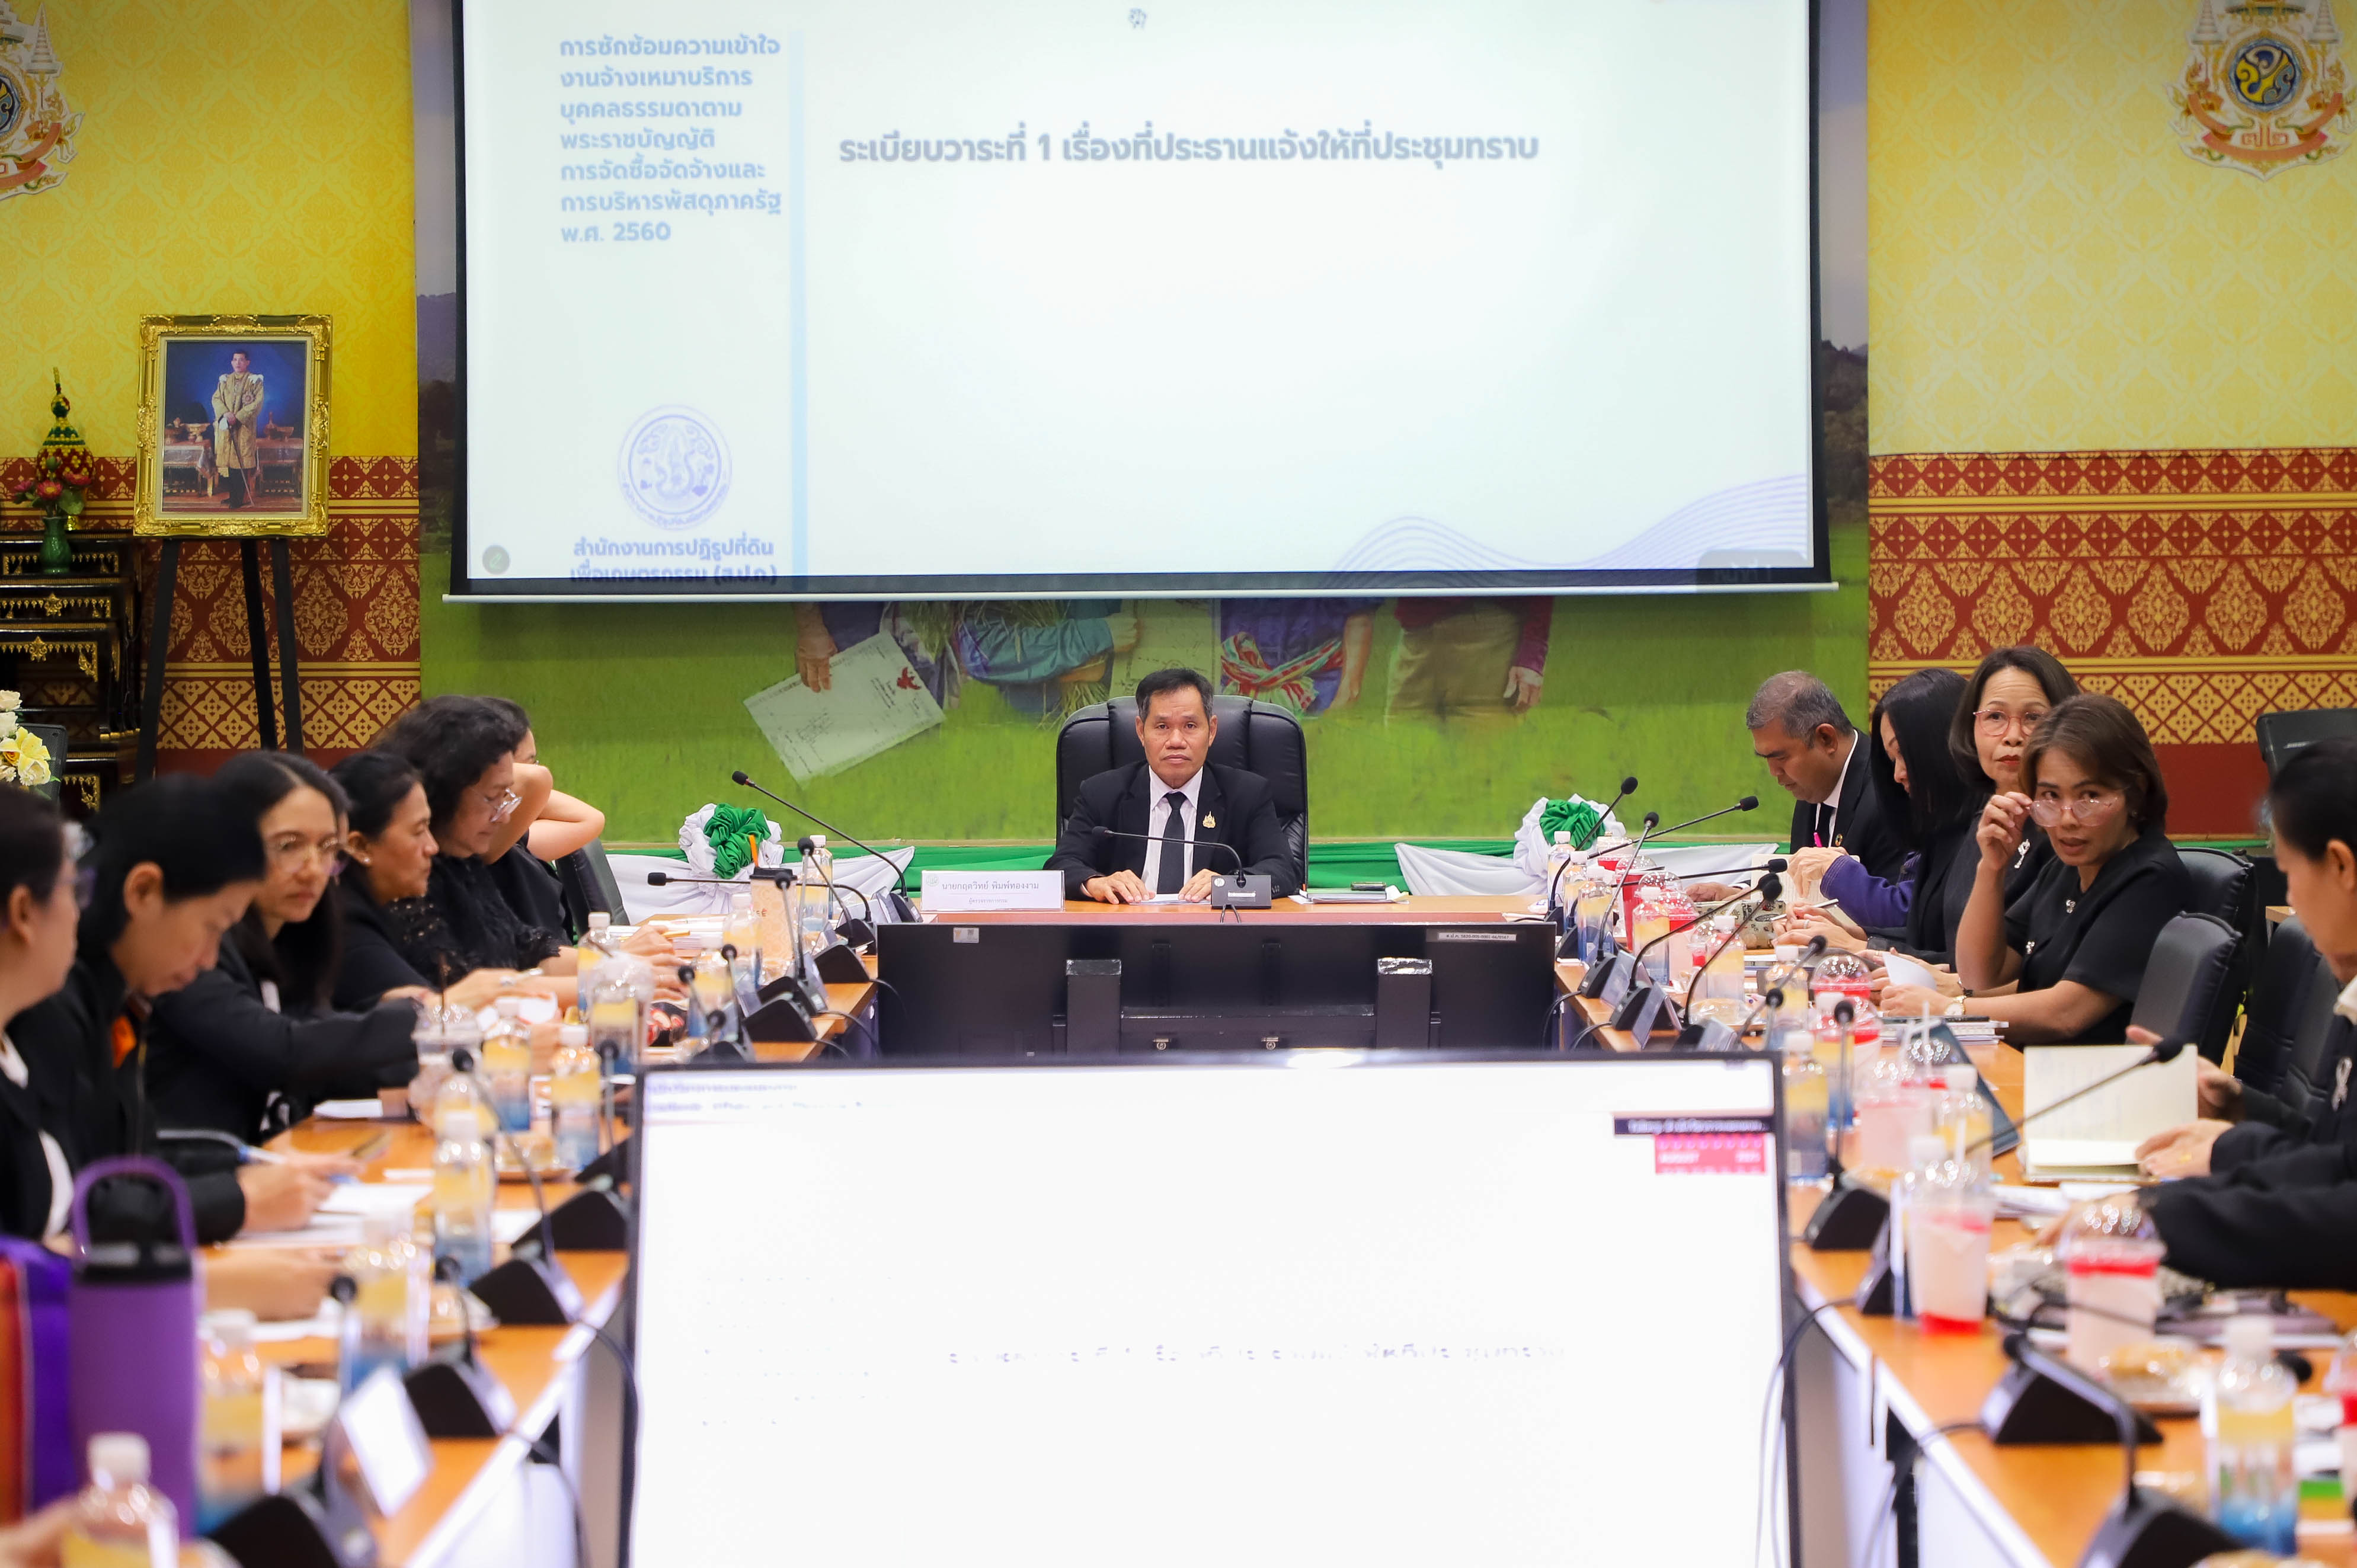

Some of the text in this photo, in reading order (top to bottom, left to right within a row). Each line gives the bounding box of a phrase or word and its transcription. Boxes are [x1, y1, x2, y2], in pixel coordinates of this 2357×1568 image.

[560, 33, 781, 56] การซักซ้อมความเข้าใจ
[560, 65, 753, 88] งานจ้างเหมาบริการ
[560, 100, 743, 125] บุคคลธรรมดาตาม
[560, 127, 715, 151] พระราชบัญญัติ
[839, 120, 1540, 170] ระเบียบวาระที่ 1 เรื่องที่ประธานแจ้งให้ที่ประชุมทราบ
[561, 153, 766, 180] การจัดซื้อจัดจ้างและ
[561, 189, 782, 216] การบริหารพัสดุภาครัฐ
[561, 222, 671, 242] พ.ศ. 2560
[574, 532, 774, 561] สำนักงานการปฏิรูปที่ดิน
